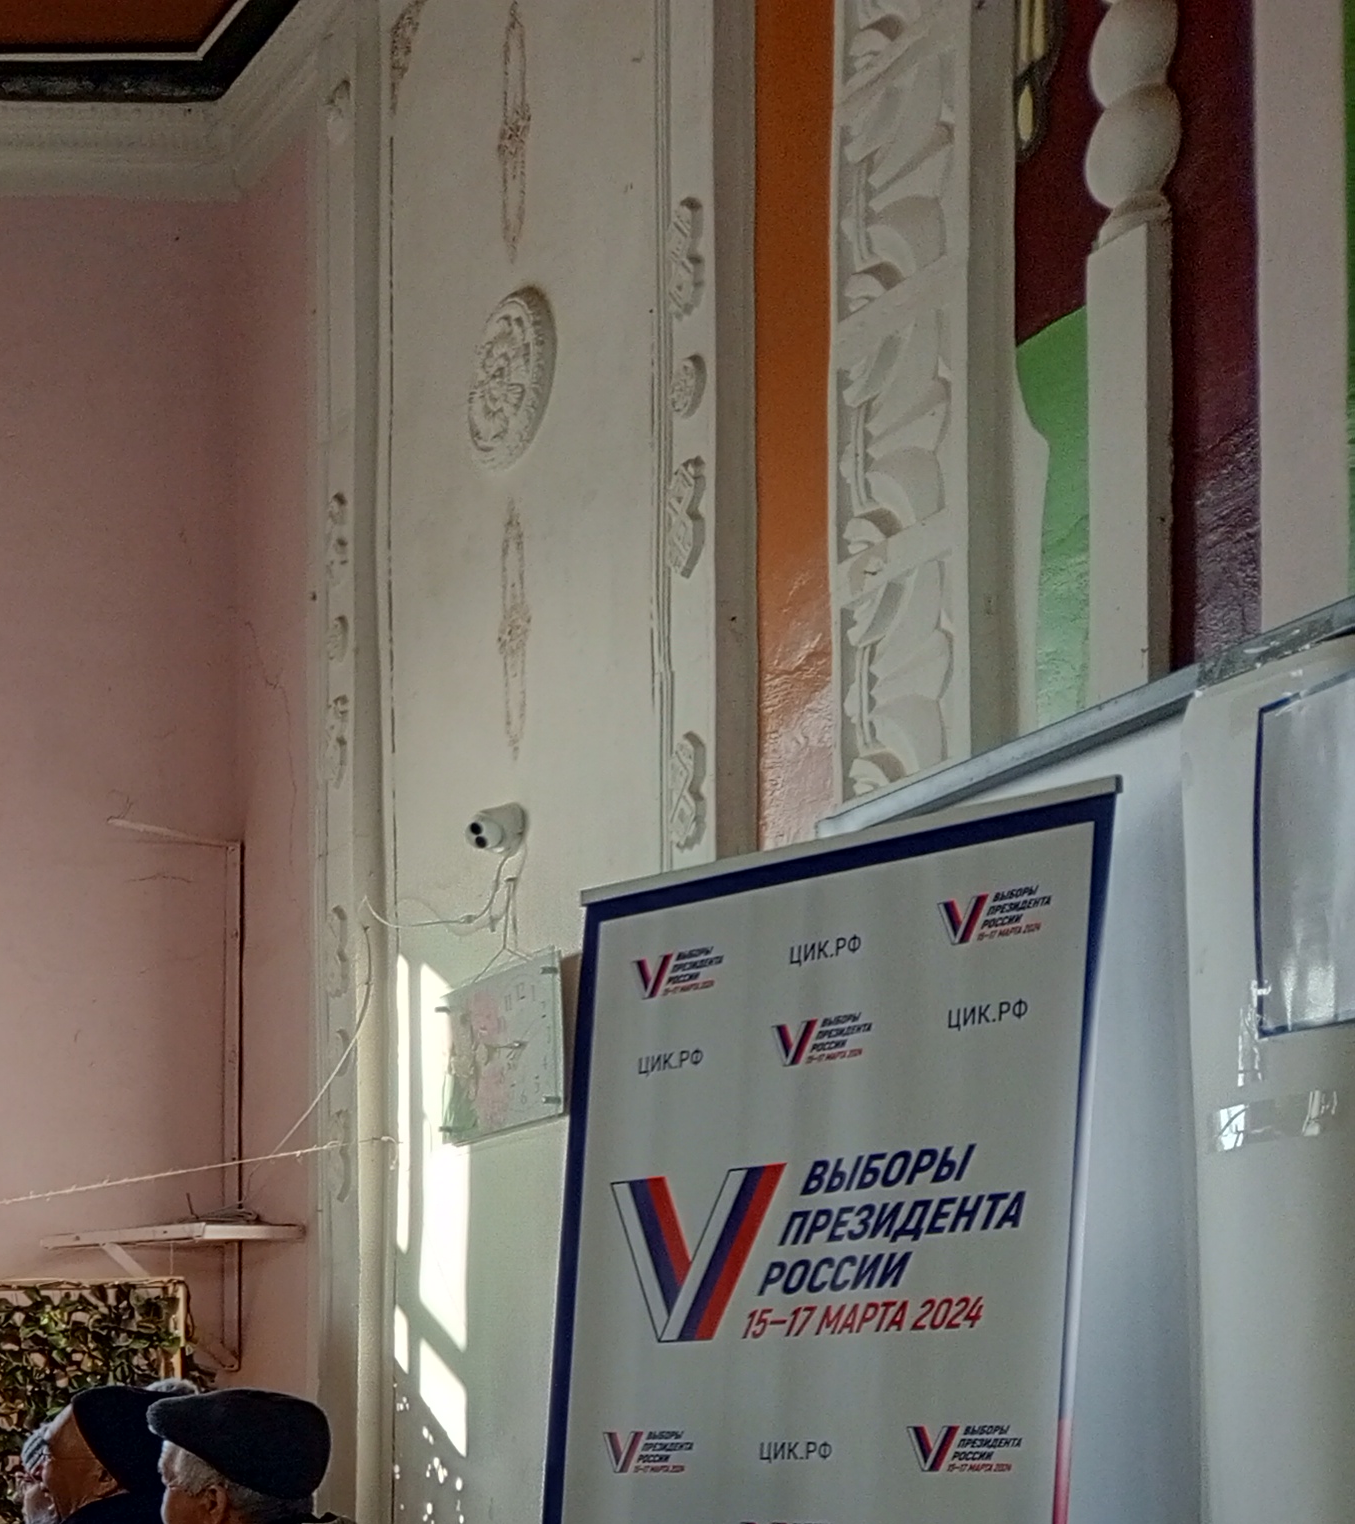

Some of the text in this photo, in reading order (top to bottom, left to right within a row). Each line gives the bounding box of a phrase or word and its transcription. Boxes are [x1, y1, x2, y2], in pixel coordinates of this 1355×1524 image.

[993, 884, 1039, 902] ВЫБОРЫ
[987, 895, 1052, 917] ПРЕЗИДЕНТА
[981, 913, 1023, 930] РОССИИ
[789, 935, 862, 966] ЦИК.РФ
[947, 999, 1028, 1031] ЦИК.РФ
[637, 1048, 703, 1076] ЦИК.РФ
[800, 1143, 976, 1195] ВЫБОРЫ
[778, 1190, 1026, 1246] ПРЕЗИДЕНТА
[757, 1251, 912, 1296] РОССИИ
[815, 1300, 908, 1335] МАРТА
[910, 1295, 984, 1330] 2024
[963, 1424, 1009, 1435] ВЫБОРЫ
[759, 1441, 832, 1463] ЦИК.РФ
[957, 1437, 1022, 1449] ПРЕЗИДЕНТА
[951, 1451, 994, 1461] РОССИИ
